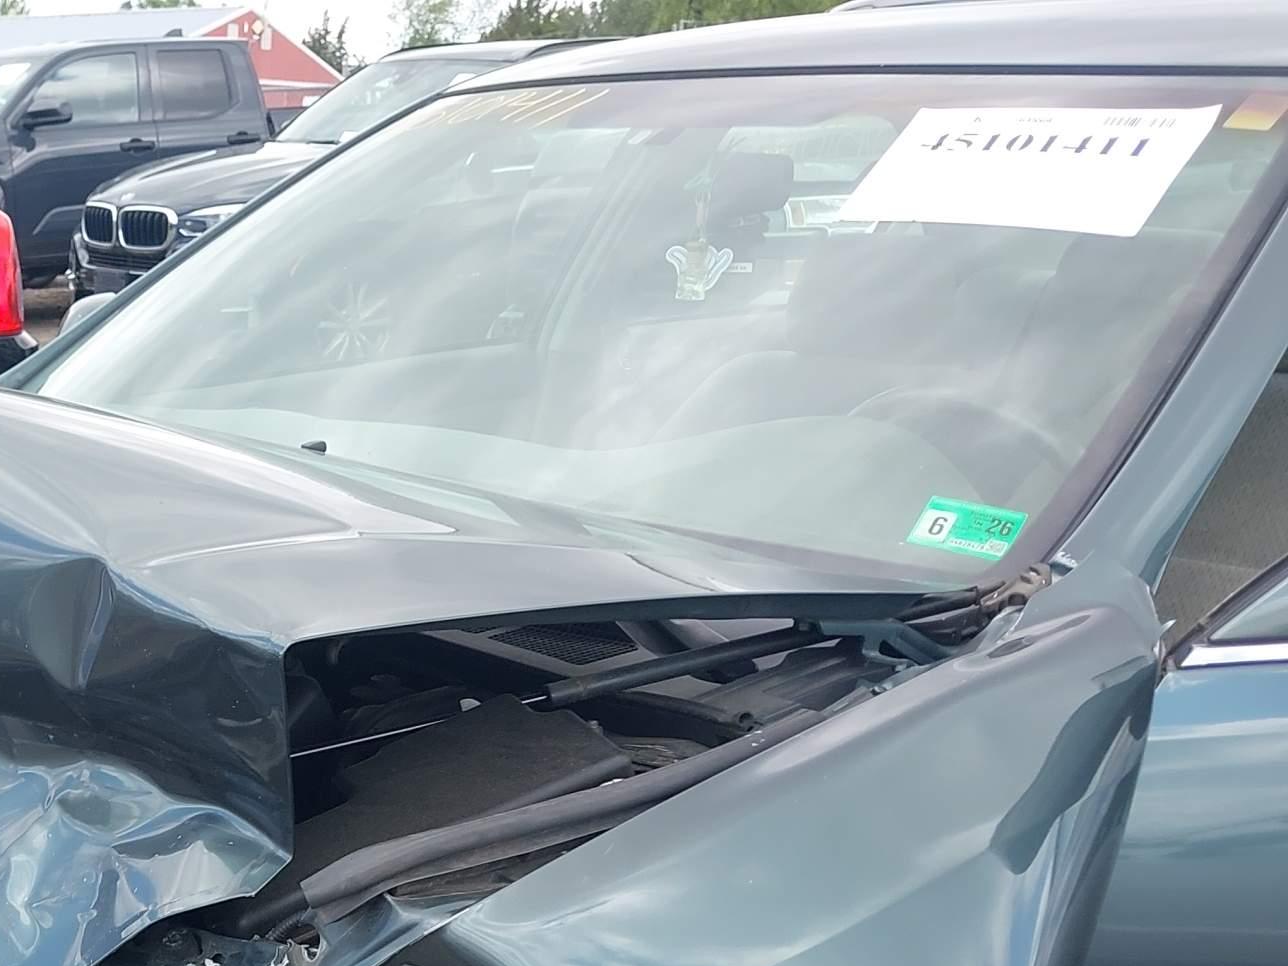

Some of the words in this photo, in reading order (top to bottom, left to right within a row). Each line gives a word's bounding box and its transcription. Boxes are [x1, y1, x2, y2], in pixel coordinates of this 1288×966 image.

[920, 132, 1152, 158] 45101411
[927, 516, 949, 536] 6
[984, 517, 1015, 537] 26
